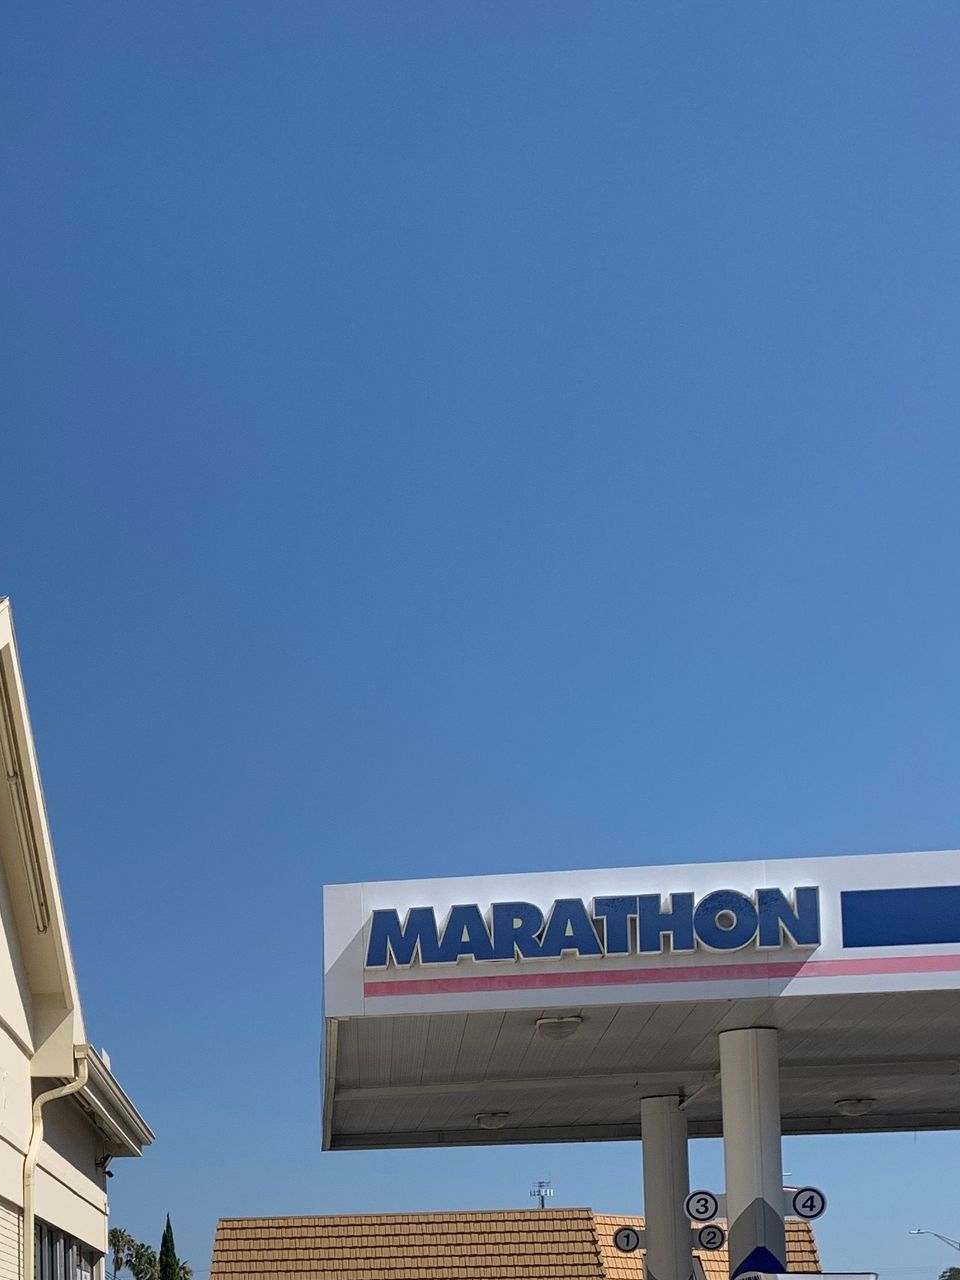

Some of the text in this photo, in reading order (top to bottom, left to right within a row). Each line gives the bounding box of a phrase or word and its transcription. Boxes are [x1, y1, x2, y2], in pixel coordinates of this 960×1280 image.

[365, 886, 820, 969] MARATHON
[695, 1197, 709, 1215] 3
[801, 1195, 816, 1212] 4
[623, 1233, 630, 1247] 1
[706, 1231, 717, 1245] 2
